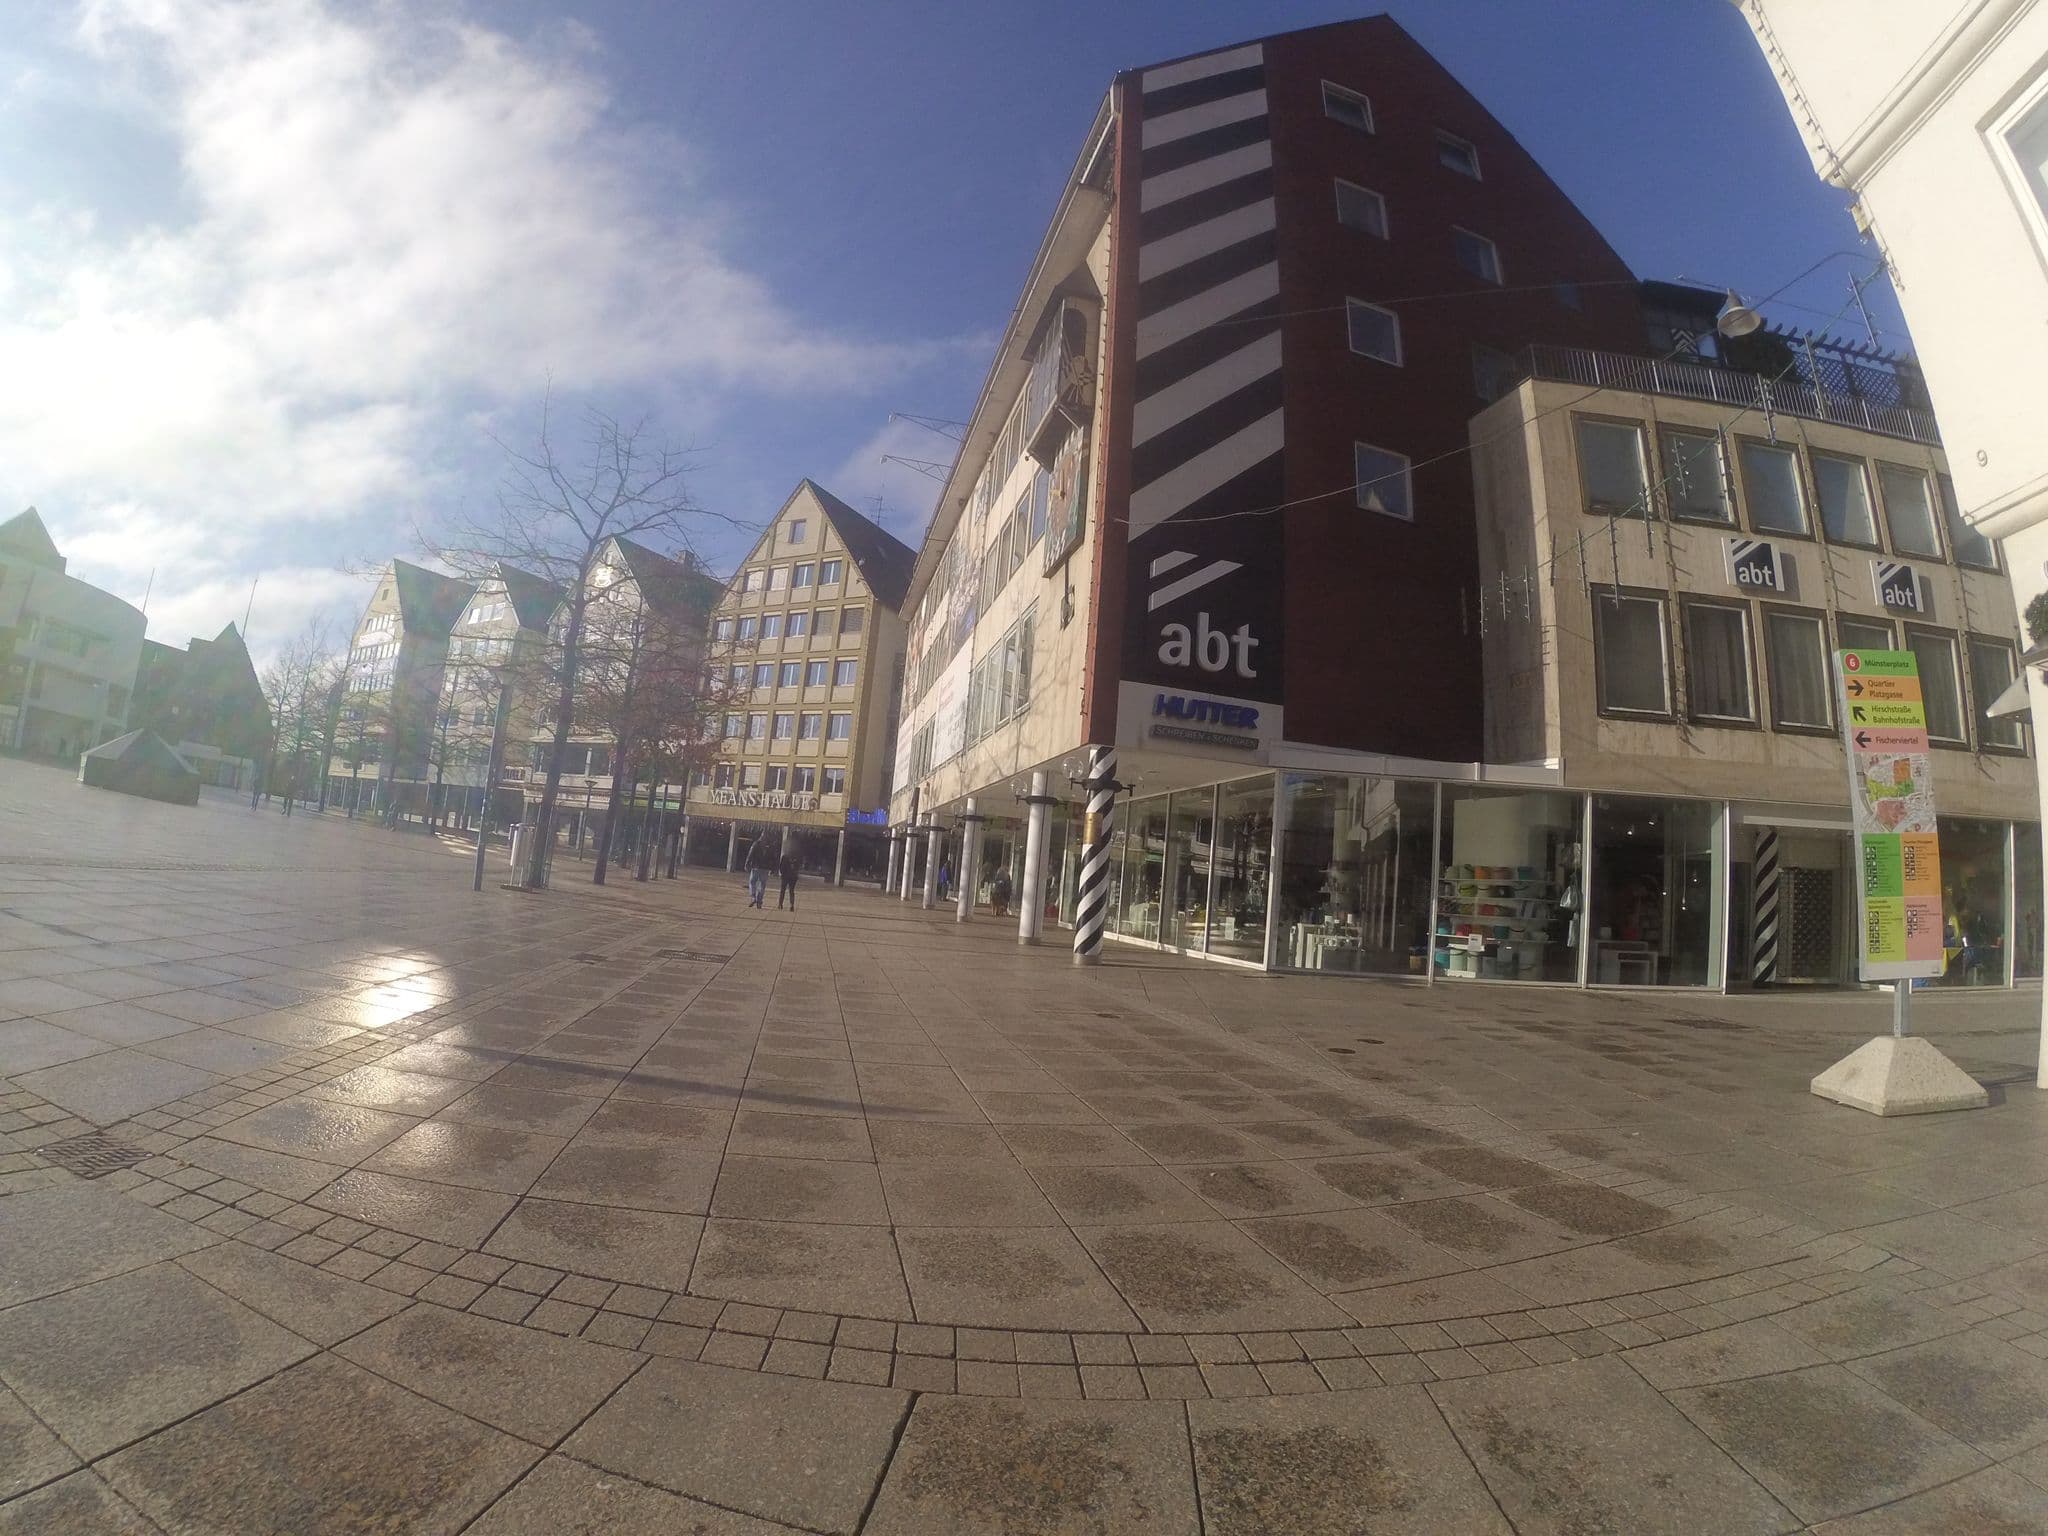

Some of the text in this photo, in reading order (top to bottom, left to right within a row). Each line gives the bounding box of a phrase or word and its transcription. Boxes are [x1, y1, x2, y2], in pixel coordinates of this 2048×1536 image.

[1738, 562, 1773, 586] abt
[1886, 583, 1914, 608] abt
[1158, 612, 1259, 679] abt
[1864, 659, 1910, 669] Münsterplatz
[1154, 693, 1259, 729] HUTTER
[1871, 704, 1911, 713] Hirschstraße
[1872, 716, 1920, 724] Bahnhofstraße
[1875, 736, 1919, 744] Fischerviertel
[710, 789, 811, 811] YEANS HALLE
